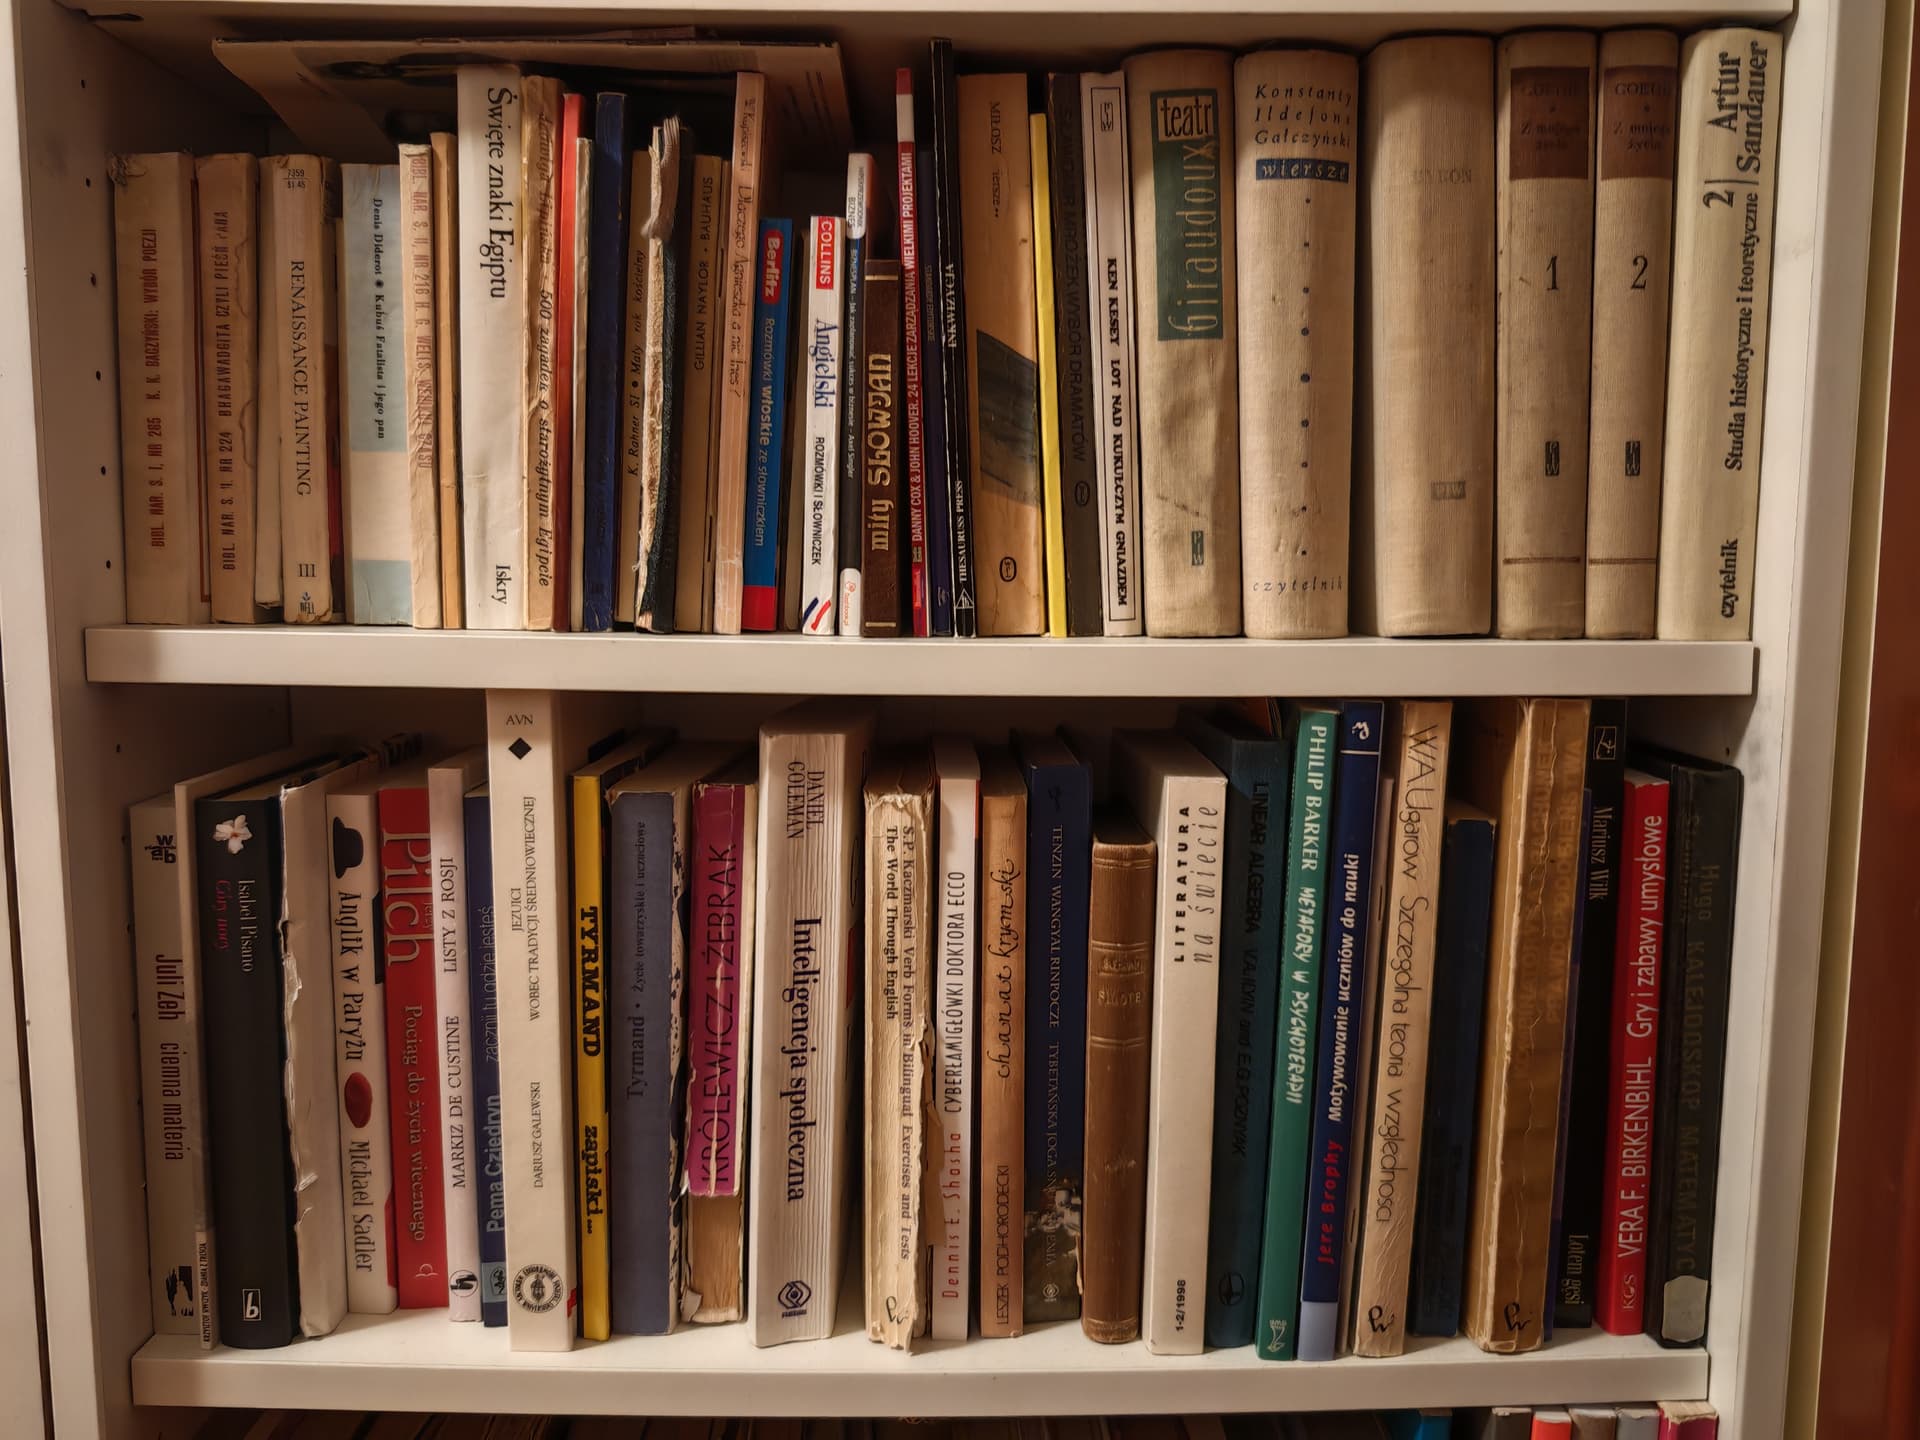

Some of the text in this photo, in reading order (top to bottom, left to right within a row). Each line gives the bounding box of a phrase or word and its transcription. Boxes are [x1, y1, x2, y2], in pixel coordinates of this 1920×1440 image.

[1159, 97, 1213, 139] teatr
[1255, 86, 1352, 103] Konstanty
[1709, 51, 1741, 133] Artur
[1735, 40, 1768, 174] Sandauer
[480, 87, 515, 298] Święte znaki Egiptu
[736, 184, 755, 249] Dlaczego
[899, 152, 913, 218] PROJEKTAMI
[1262, 160, 1348, 180] wiersze
[1702, 190, 1735, 208] 2
[140, 268, 159, 304] WYBÓR
[373, 198, 387, 380] Denis Diderot Kubuś Fatalista
[694, 176, 713, 371] GILLIAN NAYLOR BAUHAUS
[732, 255, 753, 317] Agnieszka
[819, 220, 834, 285] COLLINS
[901, 220, 915, 270] WIELKIMI
[1546, 255, 1558, 291] 1
[1630, 255, 1648, 290] 2
[215, 286, 232, 417] BHAGAWADGITA CZYLI
[903, 271, 918, 344] ZARZĄDZANIA
[943, 263, 957, 348] INKWIZYCJA
[1724, 192, 1759, 471] Studia historyczne teoretyczne
[291, 260, 311, 496] RENAISSANCE PAINTING
[755, 236, 781, 547] Berlitz Rozmówki włoskie słowniczkiem
[809, 319, 838, 408] Angielski
[1067, 290, 1086, 462] WYBÓR DRAMATÓW
[535, 327, 554, 588] zagadek starożytnym Egipcie
[628, 415, 640, 458] Rahner
[909, 446, 921, 473] JOHN
[1107, 258, 1127, 606] KEN KESEY LOT NAD KUKUŁCZYM GNIAZDEM
[811, 436, 825, 565] ROZMÓWKI SŁOWNICZEK
[868, 499, 894, 550] mity
[910, 484, 922, 506] COX
[911, 507, 923, 542] DANNY
[955, 480, 967, 583] THESAURUSS PRESS
[298, 563, 316, 578] III
[493, 565, 511, 604] Iskry
[1253, 579, 1342, 594] czytelnik
[1719, 538, 1739, 619] czytelnik
[505, 714, 534, 726] AVN
[786, 761, 806, 839] GOLEMAN
[806, 771, 825, 830] DANIEL
[384, 828, 434, 968] Pilch
[1051, 824, 1063, 879] TENZIN
[1174, 807, 1189, 963] LITERATURA
[1187, 806, 1218, 964] na świecie
[1245, 780, 1270, 934] LINEAR ALGEBRA
[1589, 807, 1613, 900] Mariusz Wilk
[238, 879, 257, 972] Isabel Pisano
[511, 886, 523, 931] JEZUICI
[523, 796, 540, 1021] WOBEC TRADYCJI ŚREDNIOWIECZNEJ
[883, 825, 900, 1021] The World Through English
[1050, 884, 1062, 953] WANGYAL
[1287, 725, 1327, 1104] PHILIP BARKER METAFORY PSYCHOTERAPII
[626, 891, 645, 1097] Tyrmand towarzyskie
[701, 843, 737, 1184] KRÓLEWICZ ŻEBRAK
[941, 871, 966, 1113] CYBERŁAMIGŁÓWKI DOKTORA ECCO
[988, 858, 1019, 1079] chanat krymski
[1049, 956, 1060, 1028] RINPOCZE
[1387, 895, 1429, 1077] Szczególna teoria
[156, 954, 188, 1160] Juli Zeh ciemna materia
[439, 858, 466, 1188] MARKIZ DE CUSTINE LISTY ROSJI
[780, 917, 822, 1203] Inteligencja społeczna
[900, 825, 915, 1261] S.P. Kaczmarski Verb Forms Bilingual Exercises and Tests
[1317, 853, 1359, 1264] Jere Brophy Motywowanie uczniów do nauki
[1618, 815, 1662, 1258] VERA F. BIRKENBIHL Gry zabawy umysłowe
[335, 891, 376, 1273] Anglik Paryżu Michael Sadler
[581, 906, 603, 1234] TYRMAND zapiski...
[1047, 1041, 1060, 1129] TYBETAŃSKA
[403, 1005, 426, 1241] Pociąg do życia wiecznego
[530, 1081, 544, 1188] DARIUSZ GALEWSKI
[1046, 1132, 1058, 1168] JOGA
[942, 1133, 961, 1298] Dennis Shasha
[996, 1165, 1010, 1324] LESZEK PODHORODECKI
[1175, 1279, 1186, 1332] 1-2/1998
[1564, 1234, 1589, 1305] Lotem gęsi
